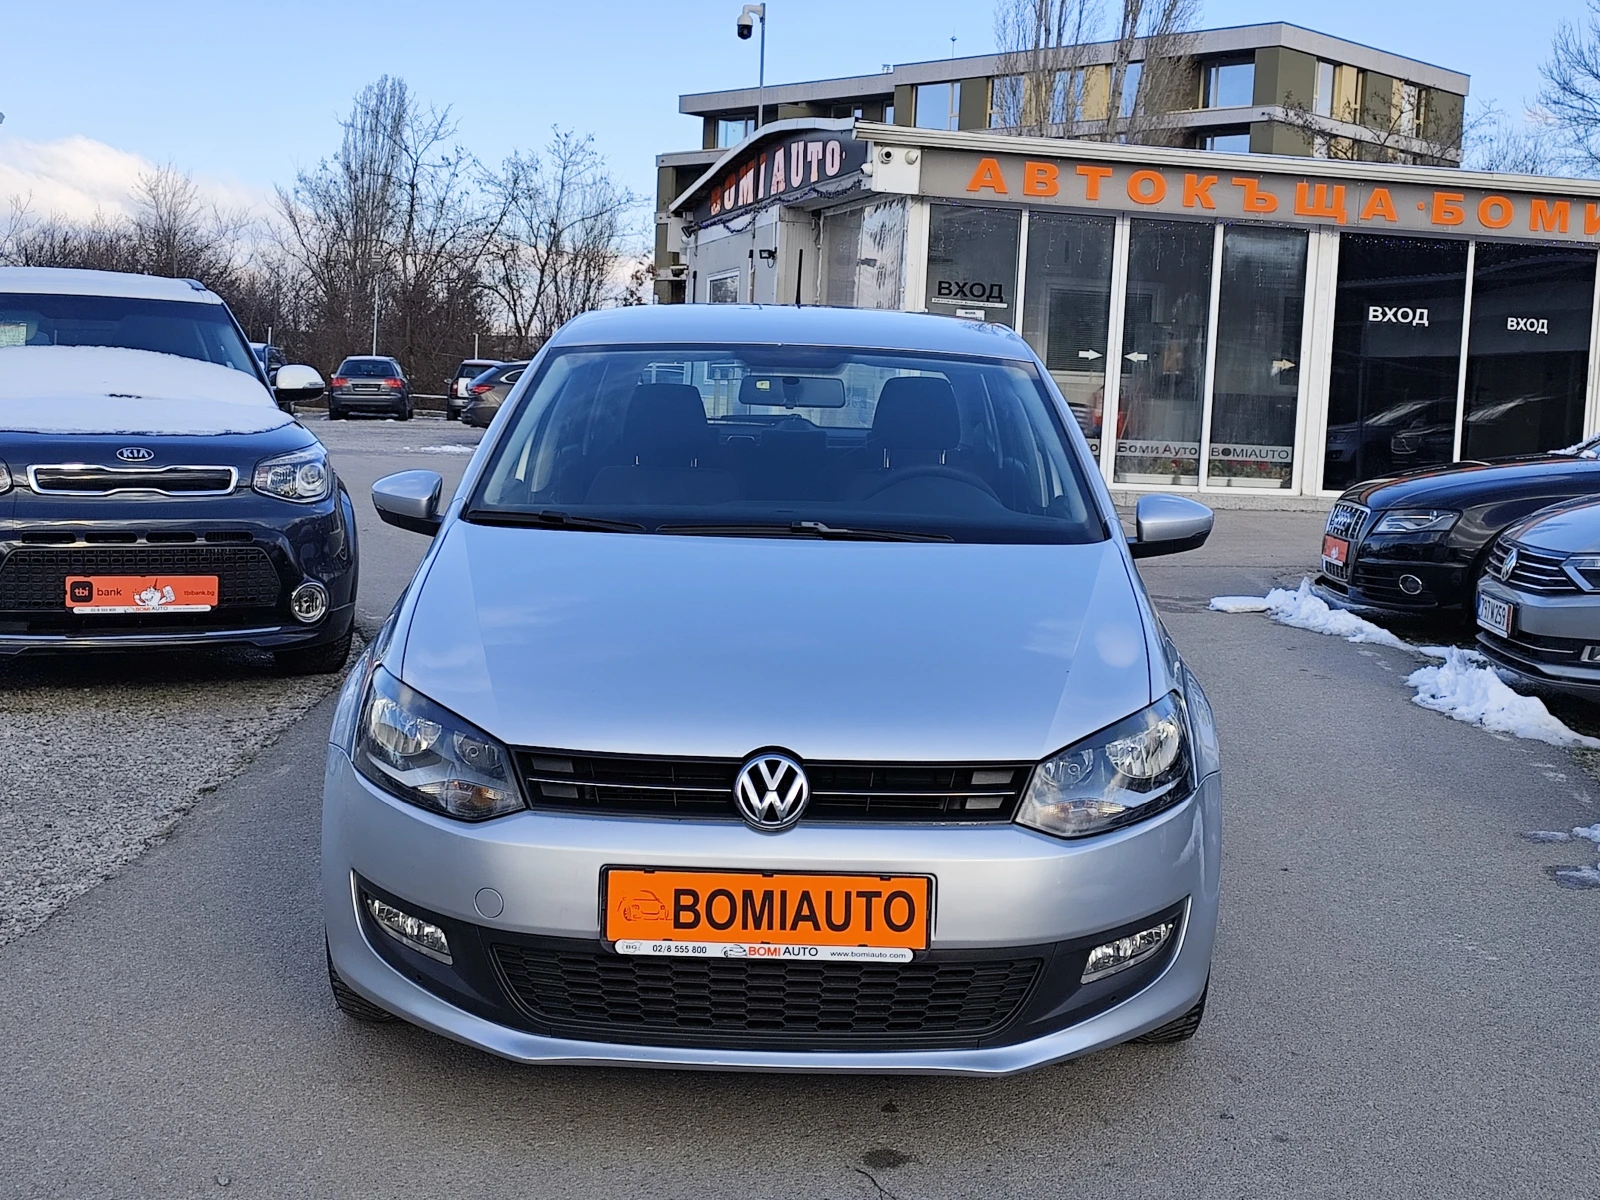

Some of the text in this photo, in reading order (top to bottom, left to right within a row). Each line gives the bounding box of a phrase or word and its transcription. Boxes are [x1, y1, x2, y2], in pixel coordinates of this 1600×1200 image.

[966, 157, 1398, 225] АВТОКЪЩА
[938, 280, 1004, 302] ВХОД
[1368, 305, 1429, 327] ВХОД
[1507, 317, 1548, 334] ВХОД
[122, 449, 149, 458] KIA
[1117, 441, 1159, 454] Боми
[1211, 447, 1289, 460] BOMIAUTO
[74, 586, 123, 597] tbi bank
[673, 887, 917, 934] BOMIAUTO
[652, 944, 707, 954] 02/8 555 800
[748, 946, 819, 957] BOMI AUTO
[830, 951, 907, 959] www.bomiauto.com
